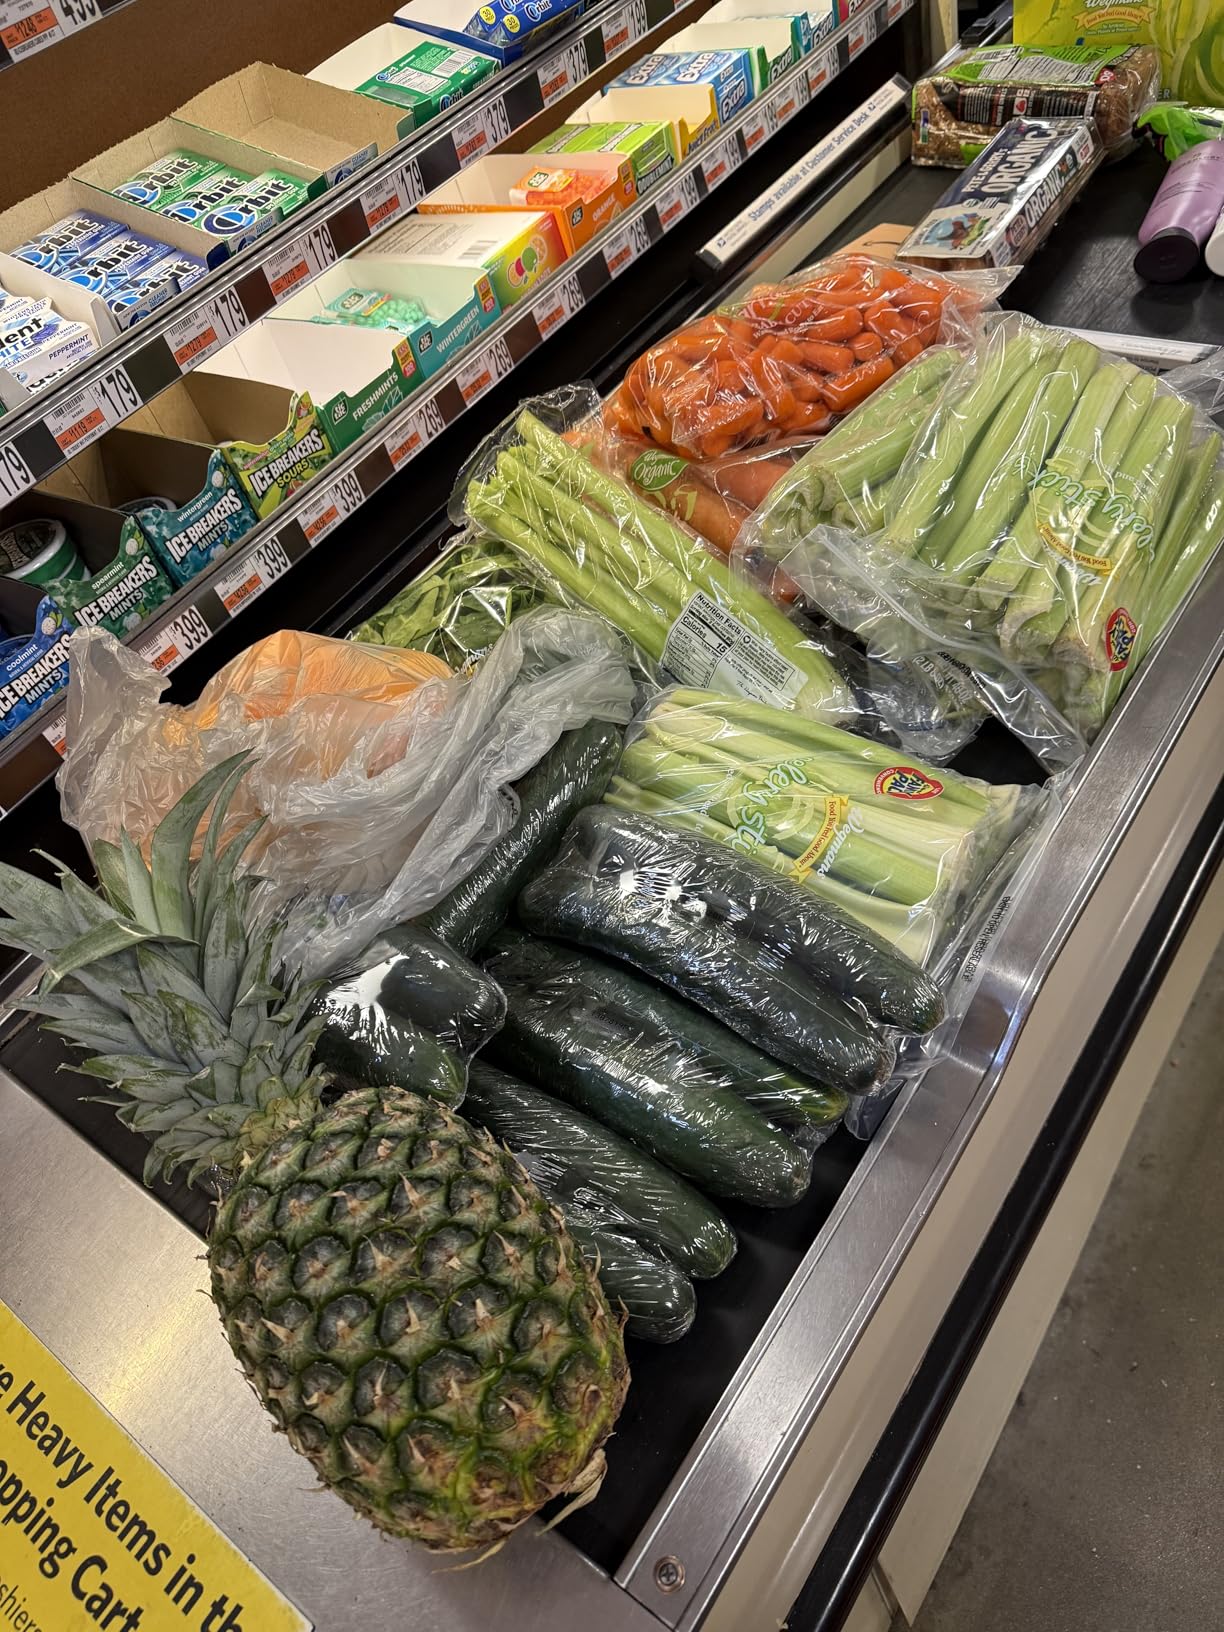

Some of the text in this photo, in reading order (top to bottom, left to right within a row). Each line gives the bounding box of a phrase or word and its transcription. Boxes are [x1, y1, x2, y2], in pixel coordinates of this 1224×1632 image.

[506, 17, 517, 28] 30
[721, 78, 745, 123] Extra
[750, 111, 871, 221] Stamps available at Customer Service Desk
[981, 126, 1058, 194] ORGANIC
[201, 178, 294, 236] Orbit
[48, 333, 90, 361] PEPPERMINT
[436, 306, 480, 353] WINTERGREEN
[352, 371, 398, 421] FRESHMINTS
[249, 428, 325, 499] ICE BREAKERS
[277, 458, 309, 488] SOURS
[633, 456, 681, 487] Organic
[165, 488, 243, 564] ICE BREAKERS
[176, 491, 213, 523] wintergreen
[199, 522, 229, 551] MINTS
[74, 555, 158, 627] ICE BREAKERS
[91, 561, 125, 591] spearmint
[110, 589, 145, 621] MINTS
[696, 593, 743, 635] Nutrition Facts
[681, 614, 728, 654] Calories 15
[6, 643, 39, 672] coolmint
[13, 632, 71, 697] BREAKERS
[25, 670, 63, 705] MINTS
[828, 800, 838, 819] Food
[813, 834, 829, 854] Good
[817, 807, 867, 879] Wegmans
[821, 826, 834, 839] Feel
[0, 1366, 14, 1396] e
[6, 1380, 94, 1489] Heavy
[83, 1466, 171, 1577] Items
[70, 1554, 144, 1632] Cart
[163, 1553, 205, 1616] in
